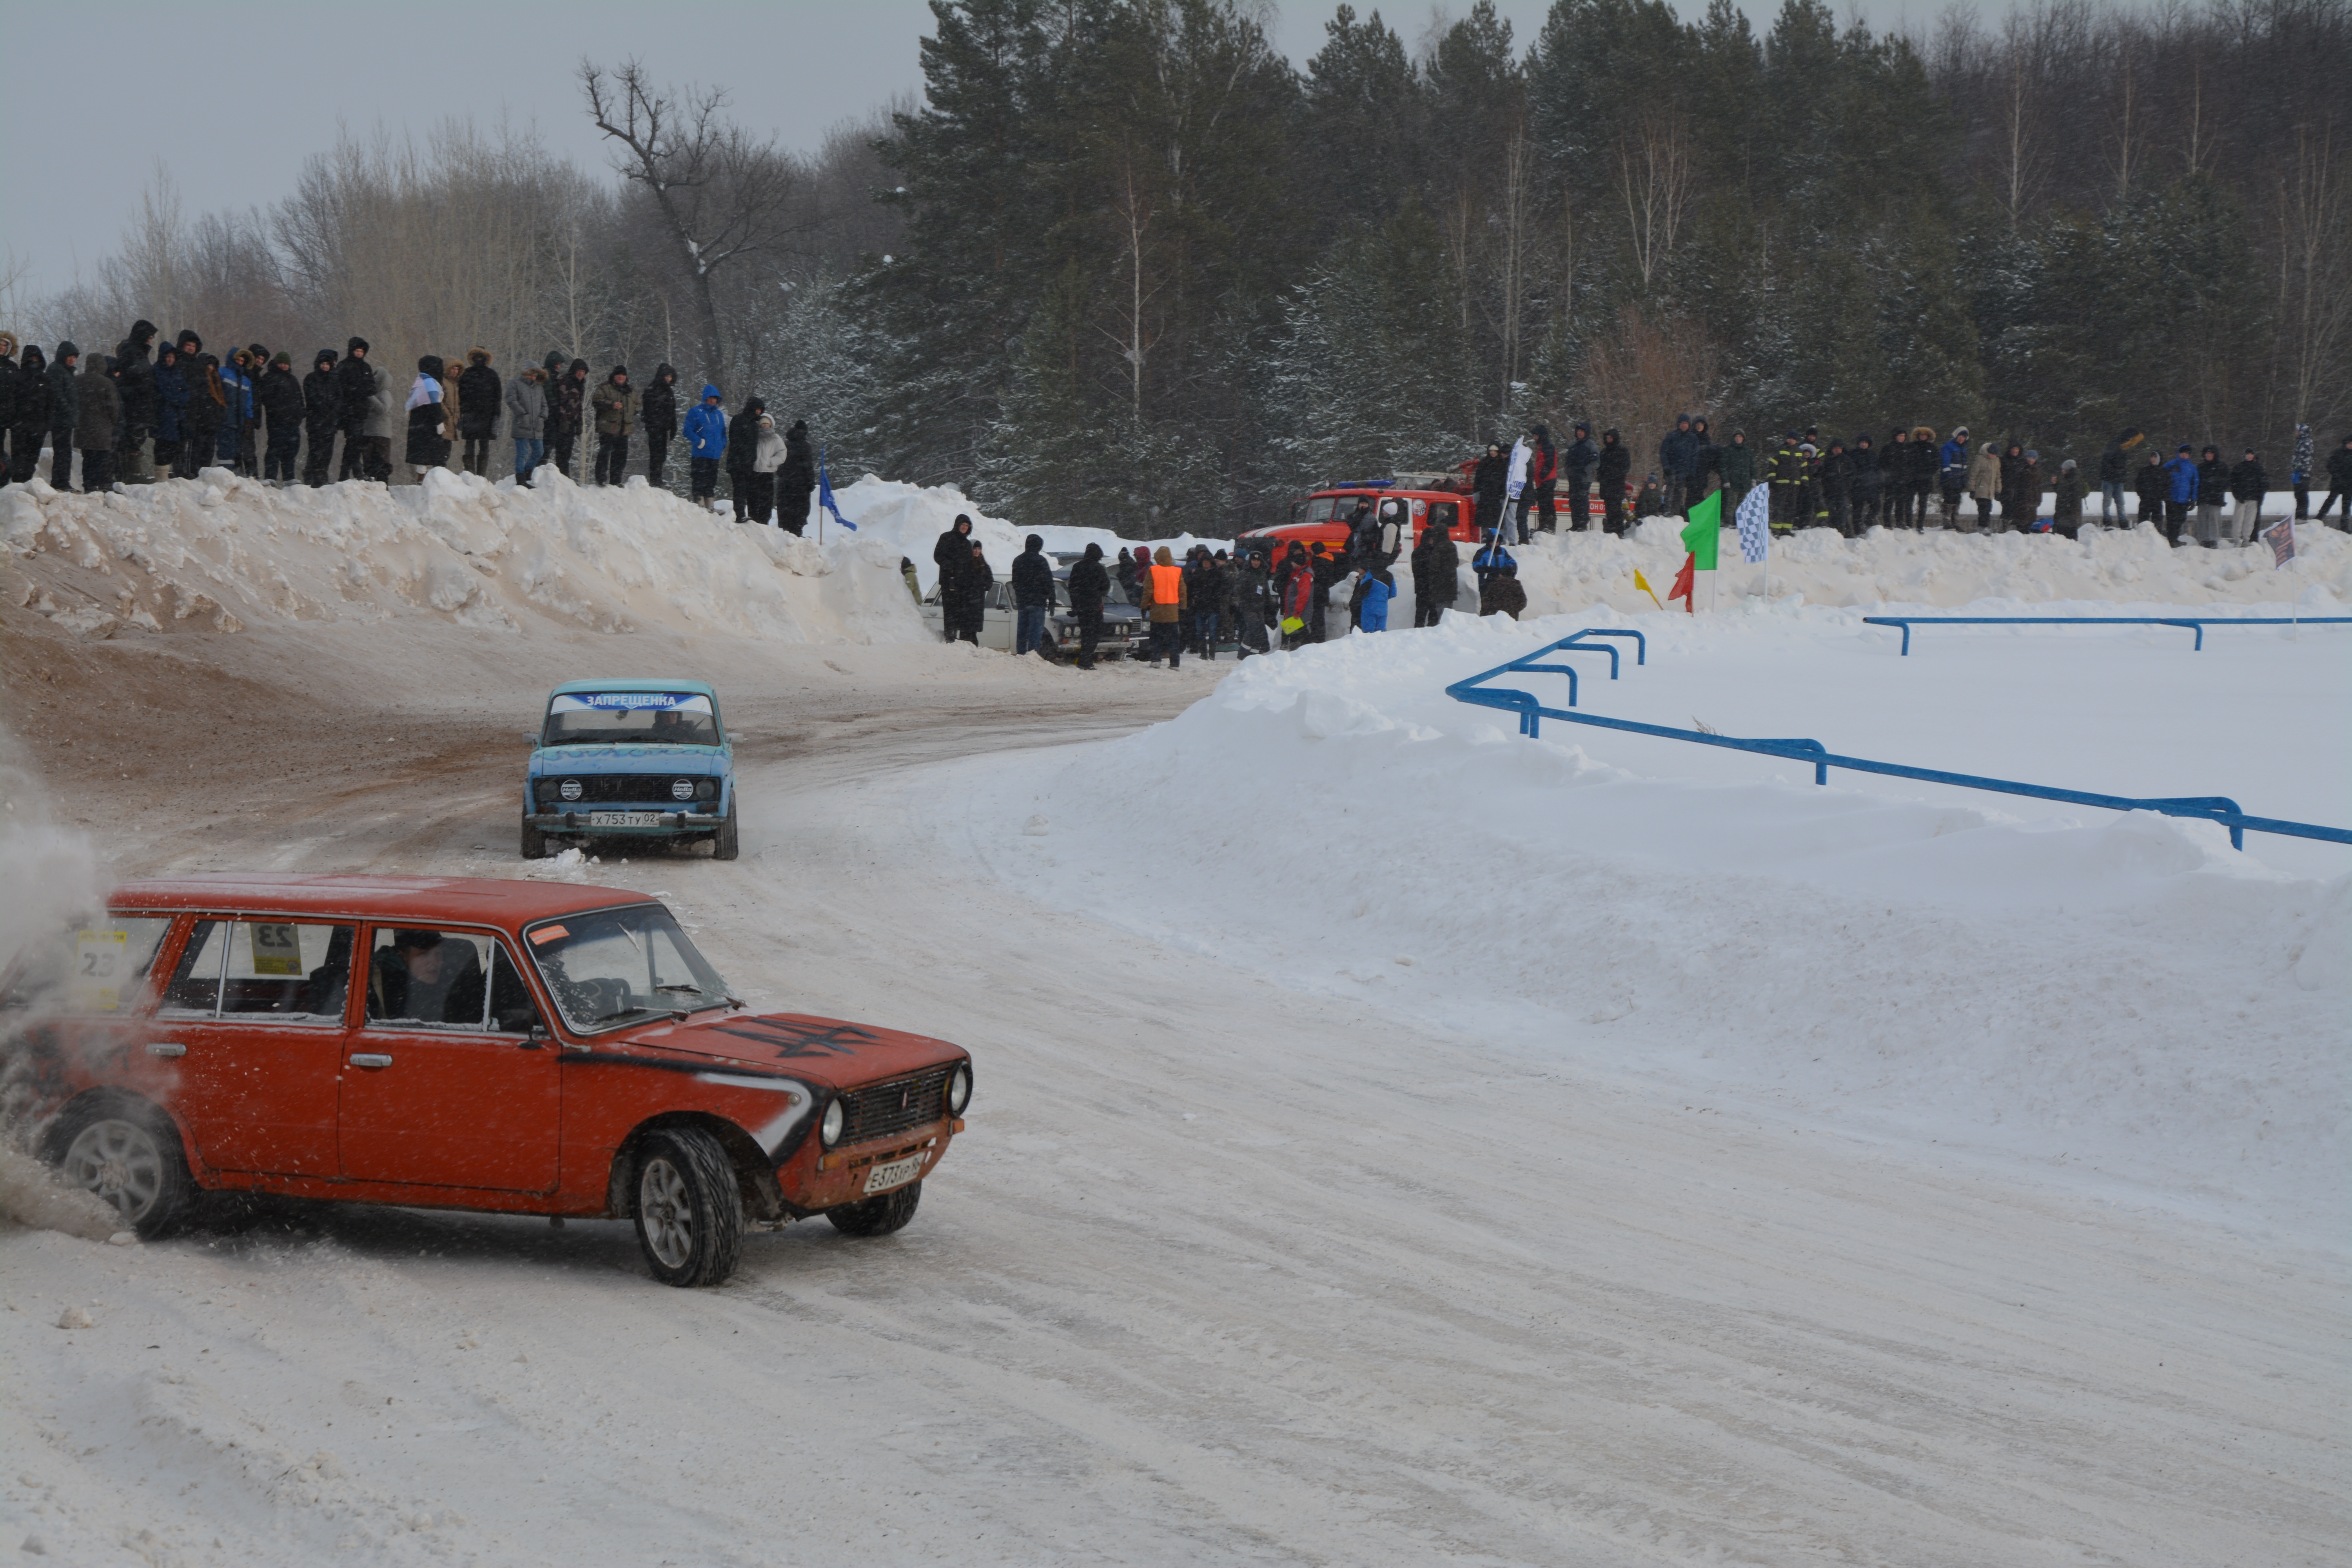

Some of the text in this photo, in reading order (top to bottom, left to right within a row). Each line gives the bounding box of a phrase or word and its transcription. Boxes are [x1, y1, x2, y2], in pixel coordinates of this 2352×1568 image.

[587, 696, 676, 706] ЗАПРЕЩЕНКА
[644, 814, 655, 822] 02
[81, 953, 115, 977] 23
